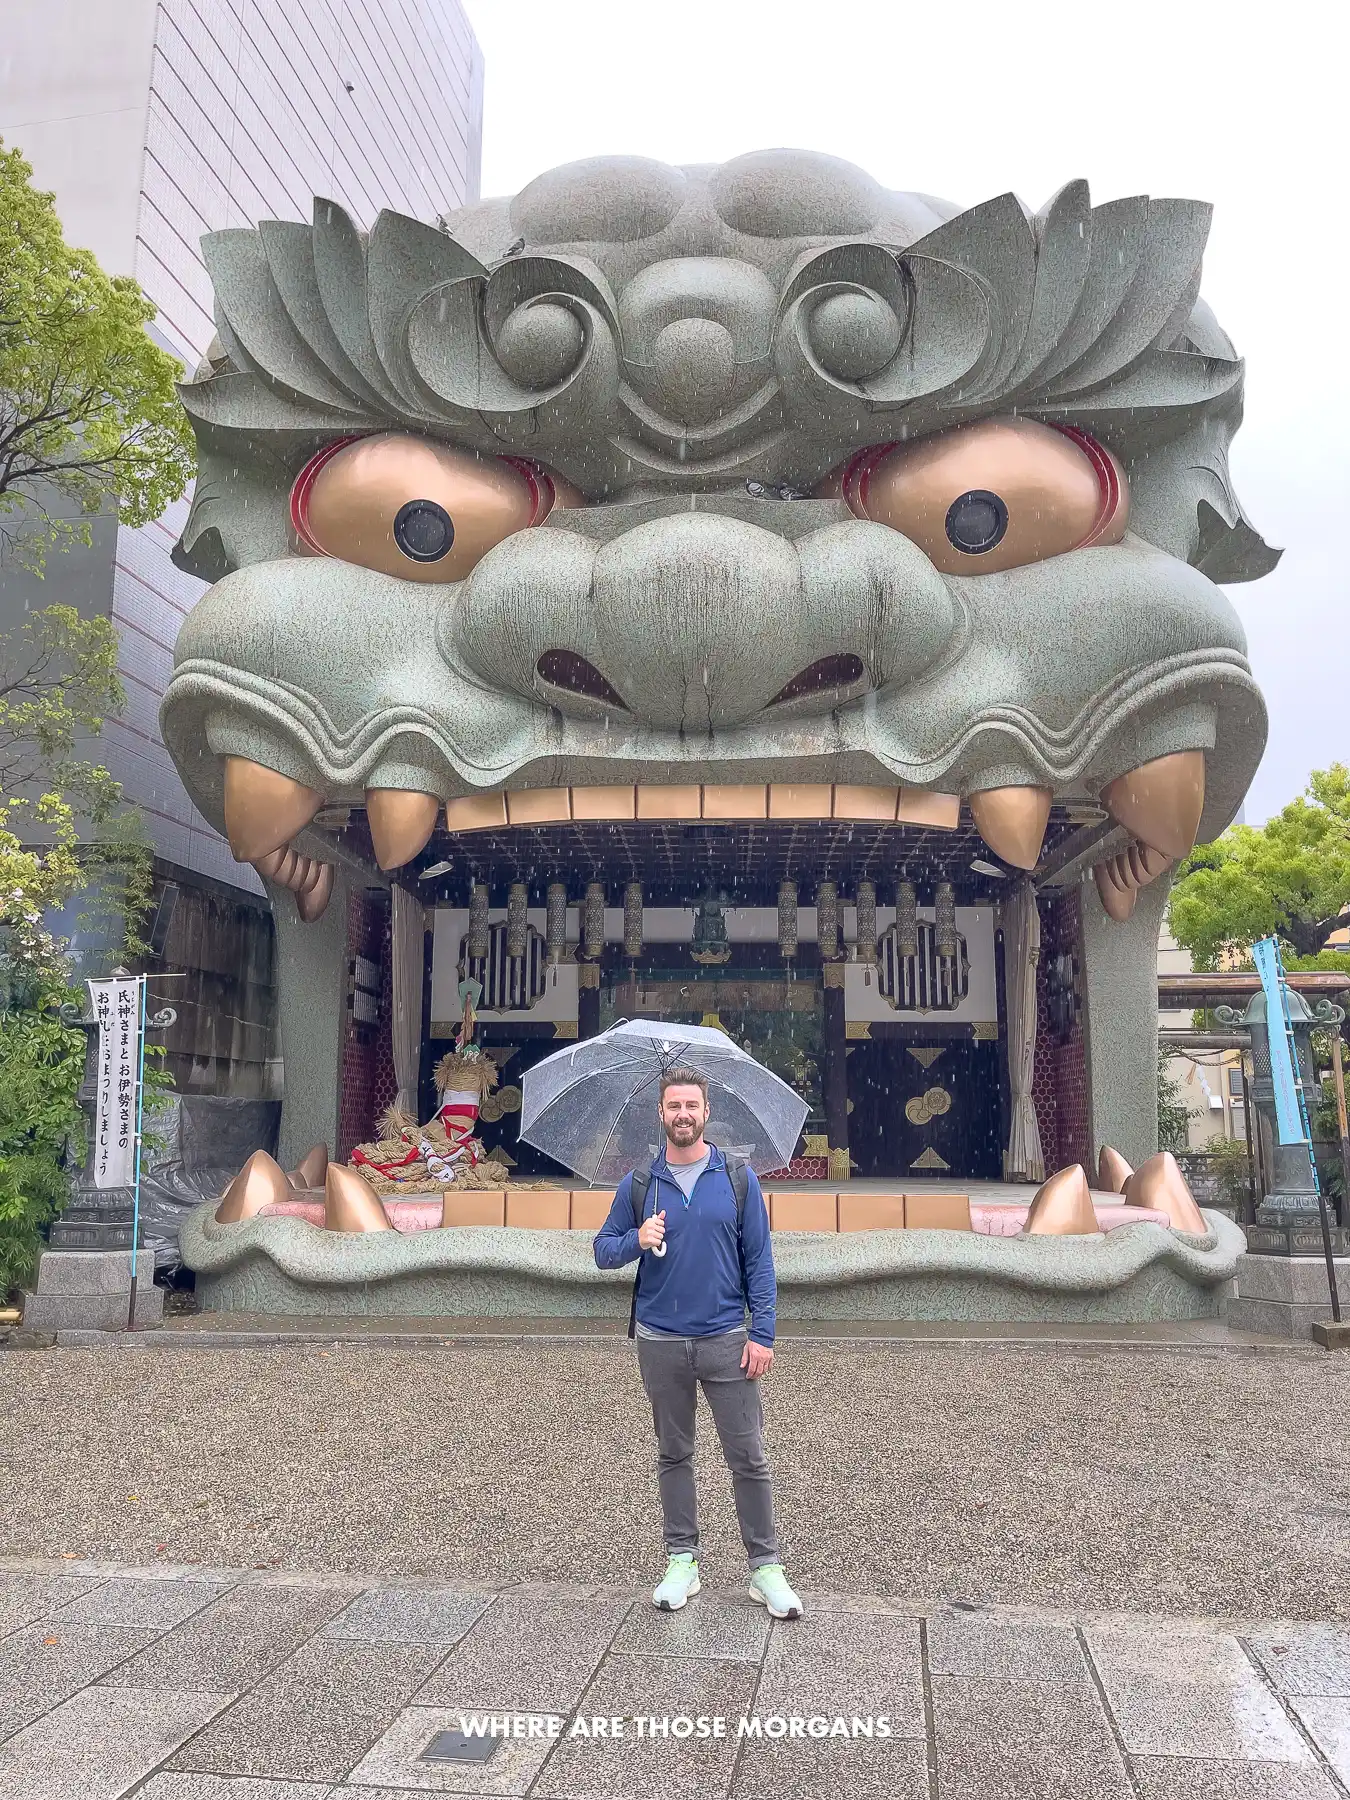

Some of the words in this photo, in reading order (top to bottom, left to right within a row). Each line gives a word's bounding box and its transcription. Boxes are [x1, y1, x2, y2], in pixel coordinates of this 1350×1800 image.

[117, 989, 131, 1149] 氏神さまとお伊勢さまの
